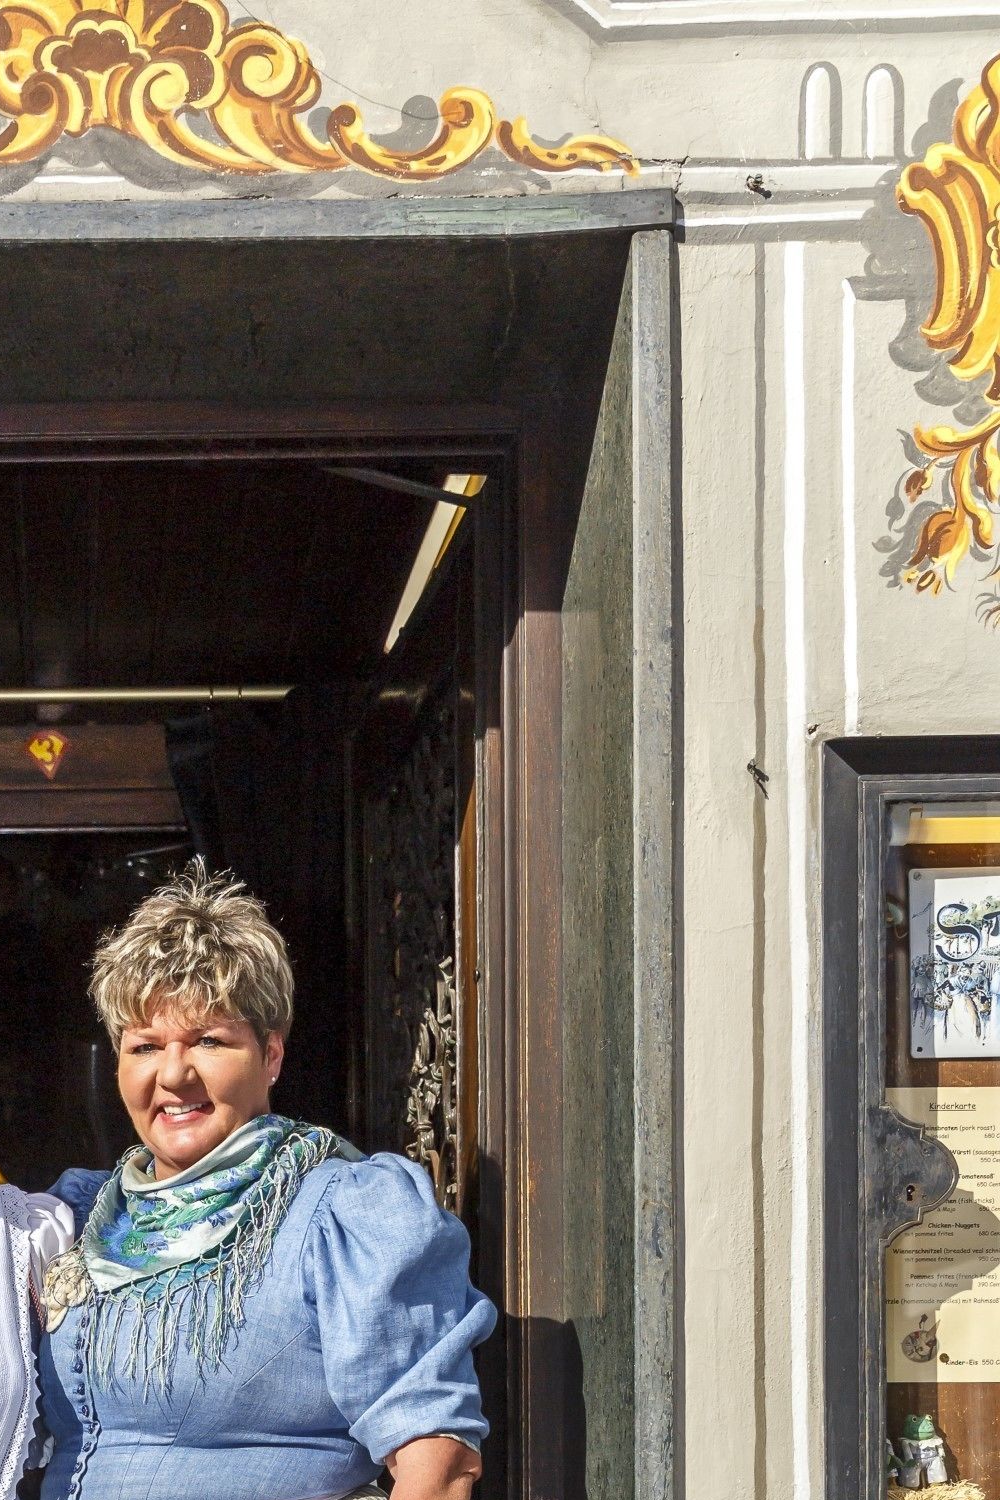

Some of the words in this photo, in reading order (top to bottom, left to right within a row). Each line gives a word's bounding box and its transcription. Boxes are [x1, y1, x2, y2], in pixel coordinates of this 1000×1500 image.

[928, 1102, 976, 1111] Kinderkarte
[959, 1124, 976, 1132] (pork
[976, 1124, 996, 1132] roast)
[958, 1197, 973, 1205] (fish
[927, 1222, 980, 1230] Chicken-Nuggets
[943, 1247, 971, 1255] (breaded
[945, 1358, 979, 1366] Kinder-Eis
